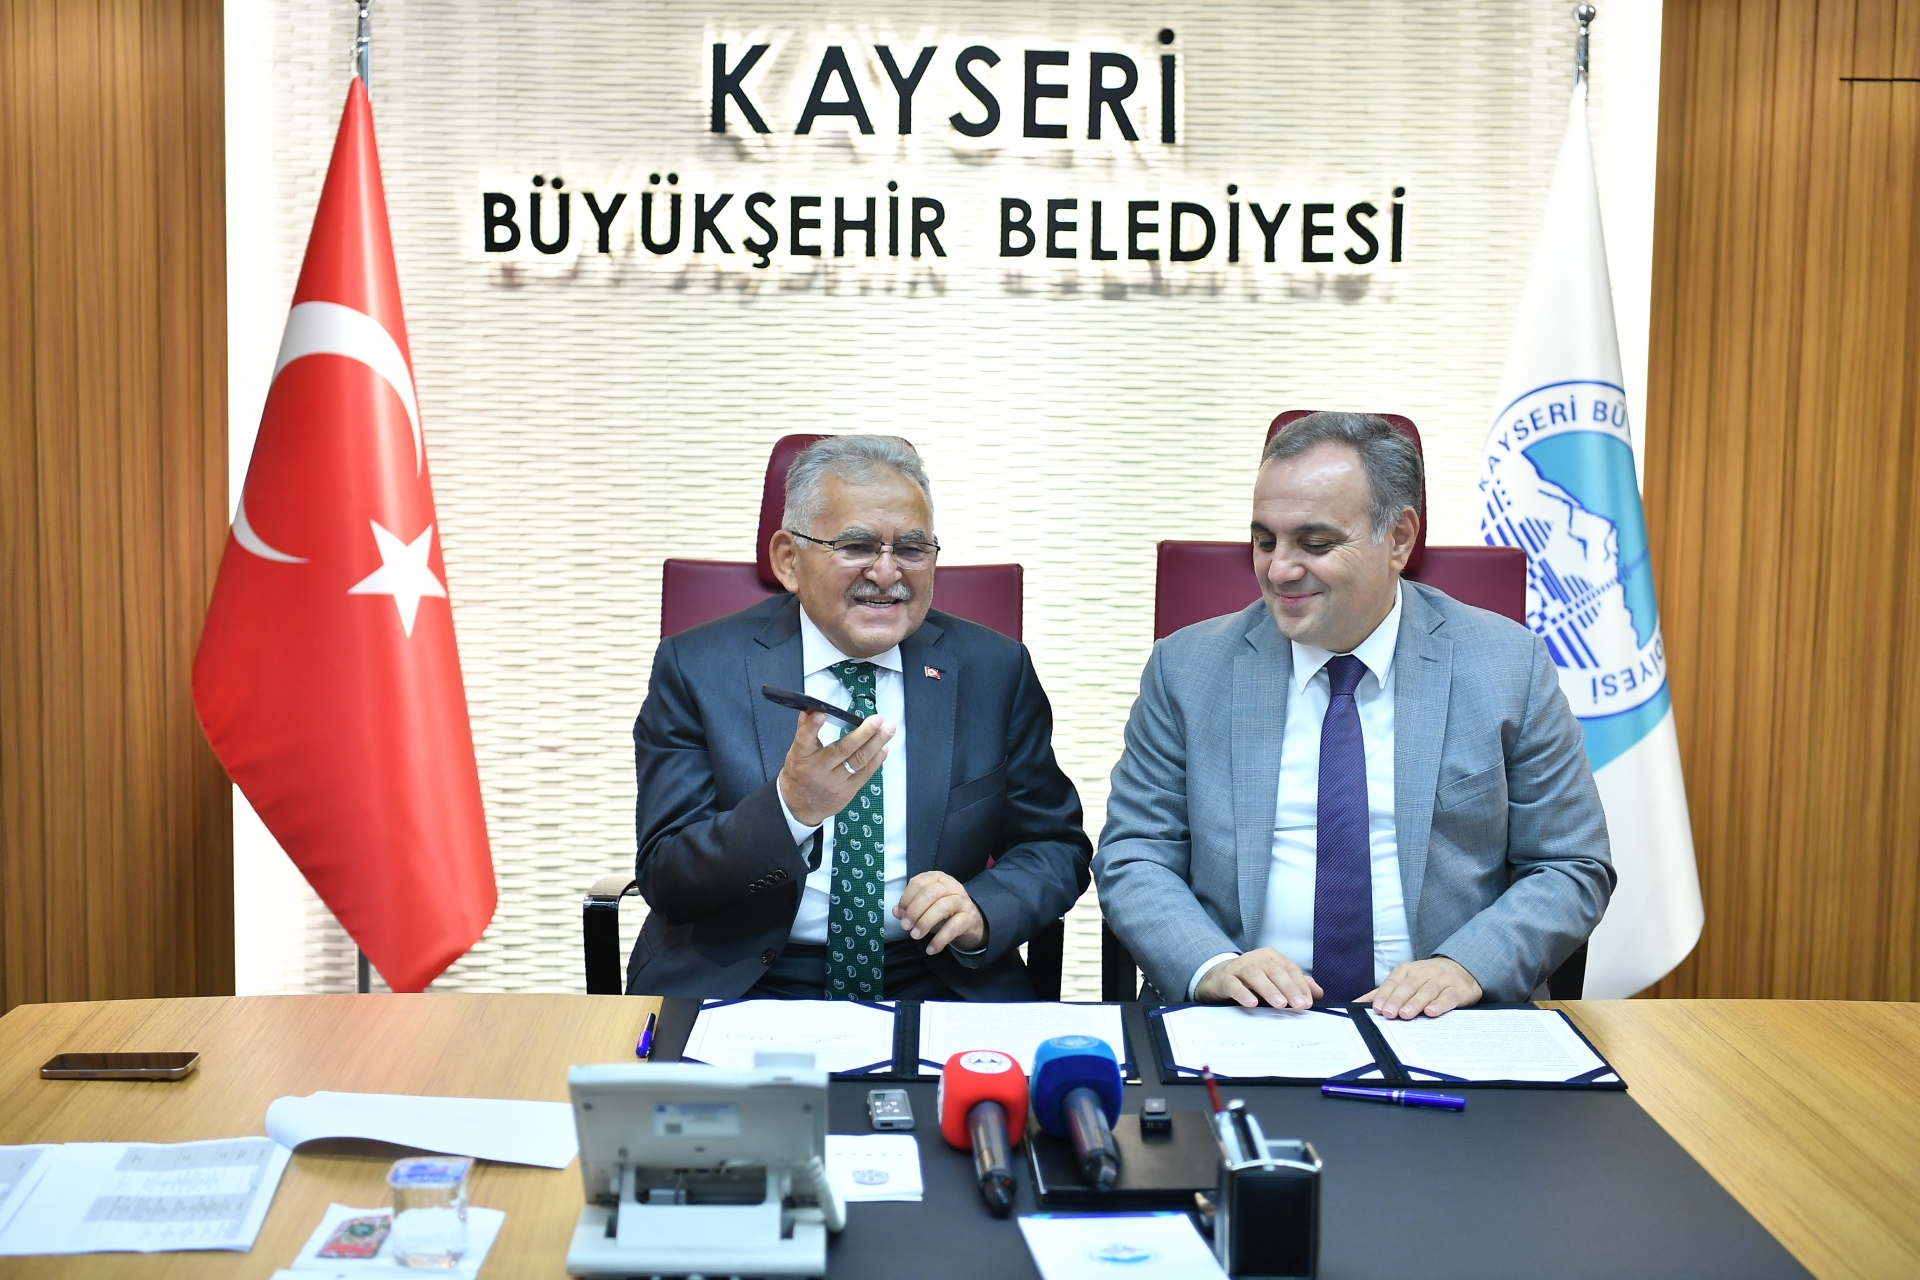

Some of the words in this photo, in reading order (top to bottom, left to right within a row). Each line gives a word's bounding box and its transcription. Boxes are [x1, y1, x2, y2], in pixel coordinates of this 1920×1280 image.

[709, 28, 1176, 144] KAYSERİ
[483, 173, 947, 269] BÜYÜKŞEHİR
[999, 184, 1406, 265] BELEDİYESİ
[1478, 394, 1577, 493] KAYSERİ
